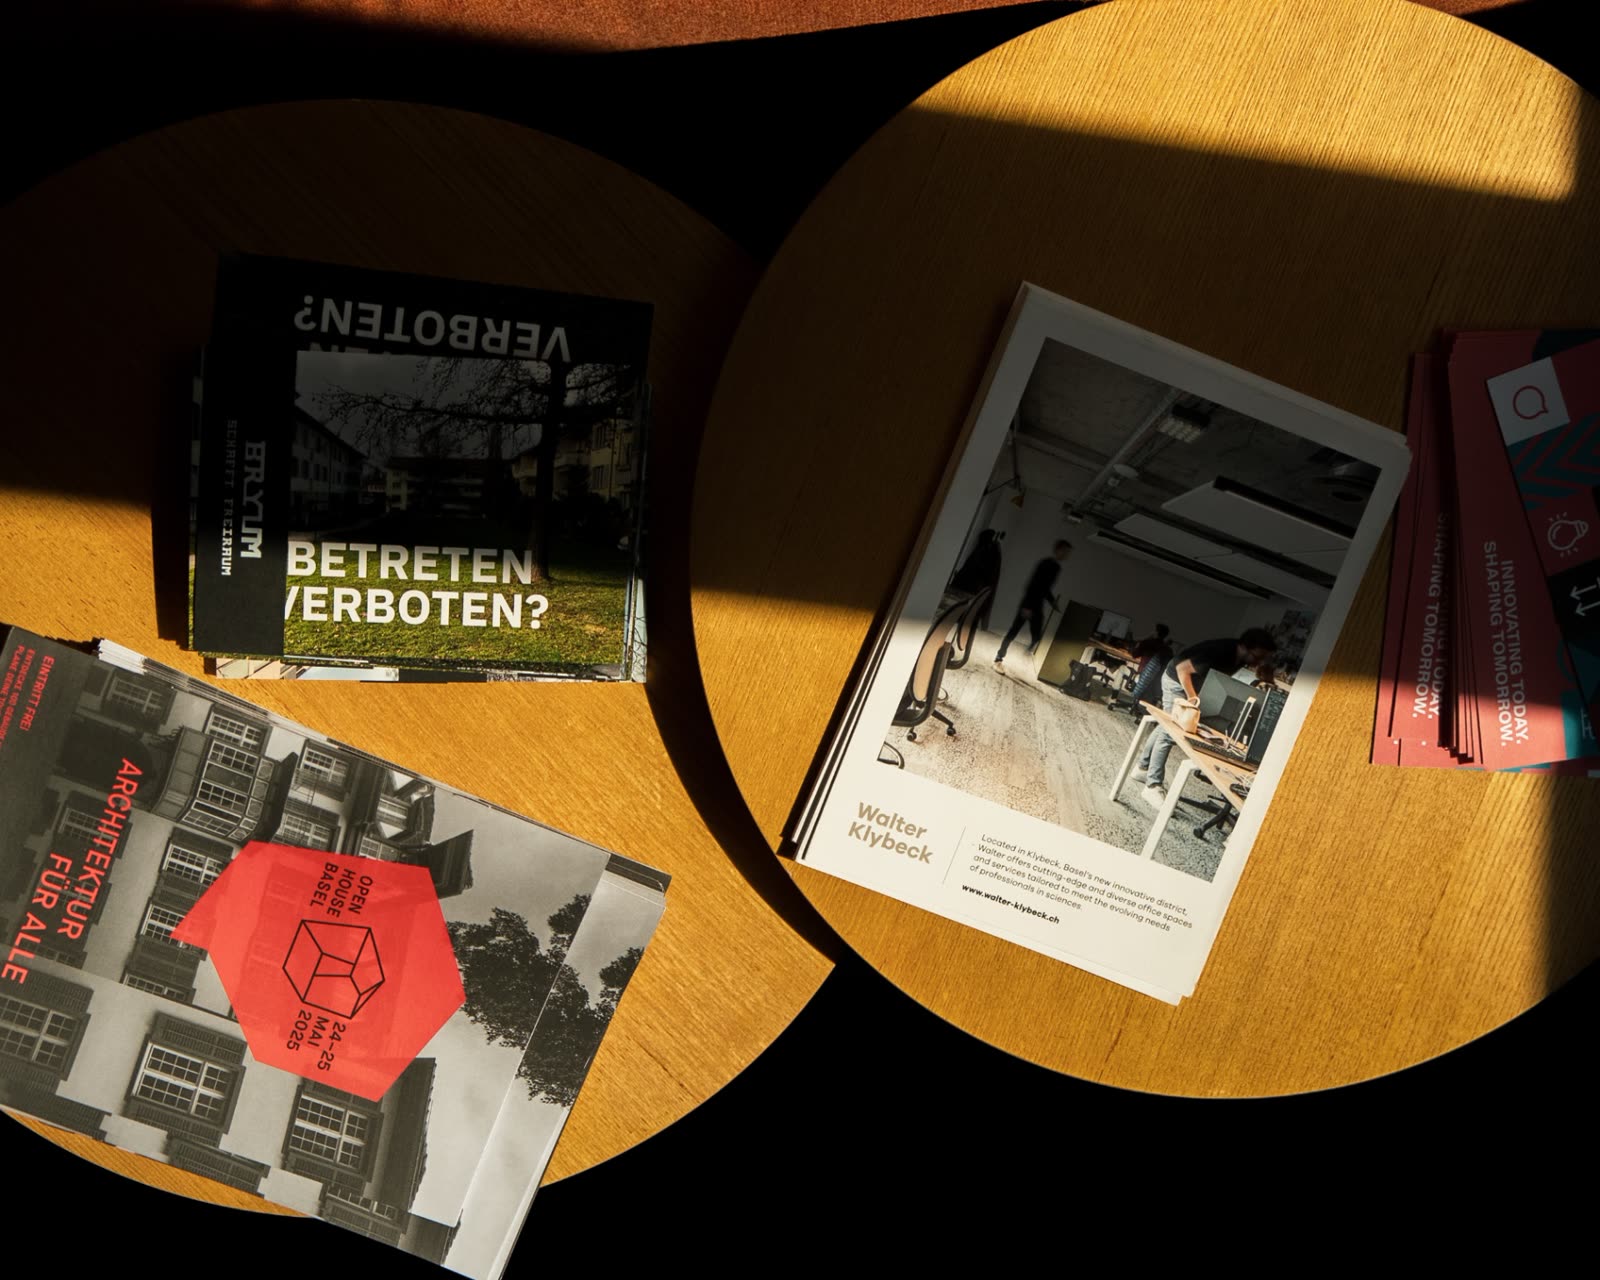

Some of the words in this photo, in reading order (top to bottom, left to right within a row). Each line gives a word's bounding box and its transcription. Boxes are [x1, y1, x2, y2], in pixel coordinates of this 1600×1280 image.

[294, 294, 572, 364] VERBOTEN?
[220, 496, 235, 577] FREIRAUM
[287, 540, 532, 585] BETRETEN
[1483, 540, 1504, 626] SHAPING
[1501, 559, 1522, 675] INNOVATING
[10, 644, 25, 672] PLANE
[14, 648, 36, 691] ENTDECKE
[28, 655, 55, 707] EINTRITT
[1412, 602, 1440, 719] TOMORROW.
[1491, 630, 1514, 747] TOMORROW.
[1508, 679, 1529, 744] TODAY.
[19, 706, 37, 731] FREI
[847, 821, 934, 865] Klybeck
[856, 800, 928, 840] Walter
[57, 758, 144, 940] ARCHITEKTUR
[31, 853, 73, 909] FÜR
[310, 862, 338, 908] BASEL
[326, 867, 357, 918] HOUSE
[348, 875, 373, 915] OPEN
[969, 864, 979, 872] of
[979, 868, 1035, 893] professionals
[1036, 889, 1045, 897] in
[1045, 892, 1082, 910] sciences.
[973, 854, 991, 865] and
[991, 862, 1026, 878] services
[1027, 873, 1060, 891] tailored
[1061, 885, 1070, 894] to
[1071, 889, 1093, 902] meet
[1094, 897, 1109, 908] the
[1109, 904, 1144, 922] evolving
[1145, 917, 1171, 932] needs
[978, 844, 1006, 859] Walter
[1006, 855, 1031, 869] offers
[1032, 864, 1088, 889] cutting-edge
[1088, 885, 1106, 896] and
[1106, 891, 1137, 908] diverse
[1137, 903, 1162, 917] office
[1162, 913, 1193, 928] spaces
[981, 834, 1016, 852] Located
[1017, 847, 1026, 855] in
[1026, 850, 1061, 869] Klybeck,
[1063, 863, 1093, 880] Basel's
[1093, 875, 1111, 887] new
[1112, 881, 1155, 904] innovative
[1156, 899, 1188, 917] district,
[962, 884, 1060, 924] www.walter-klybeck.ch
[1, 912, 47, 984] ALLE
[286, 1009, 311, 1051] 2025
[307, 1015, 330, 1048] MAI
